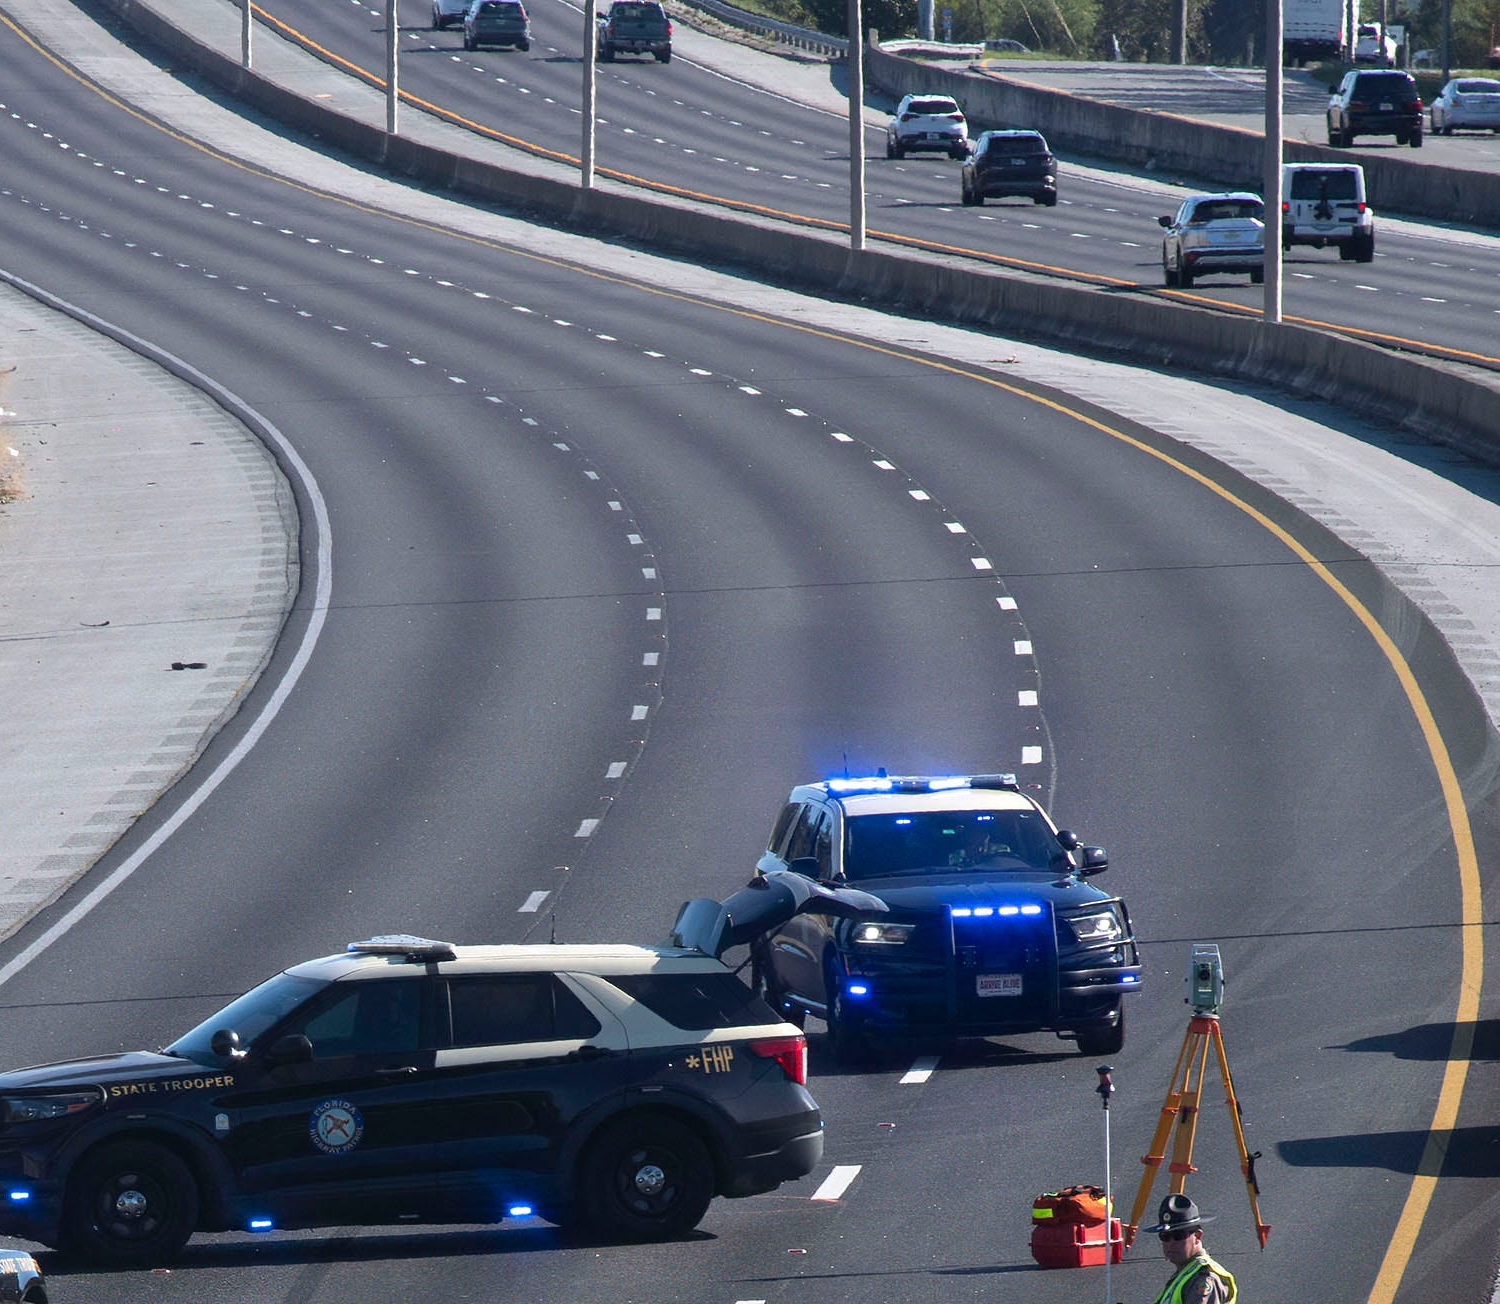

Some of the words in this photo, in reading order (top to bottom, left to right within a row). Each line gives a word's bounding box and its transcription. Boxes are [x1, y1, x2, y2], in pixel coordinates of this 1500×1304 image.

[110, 1083, 157, 1097] STATE
[161, 1076, 234, 1091] TROOPER
[314, 1100, 357, 1117] FLORIDA
